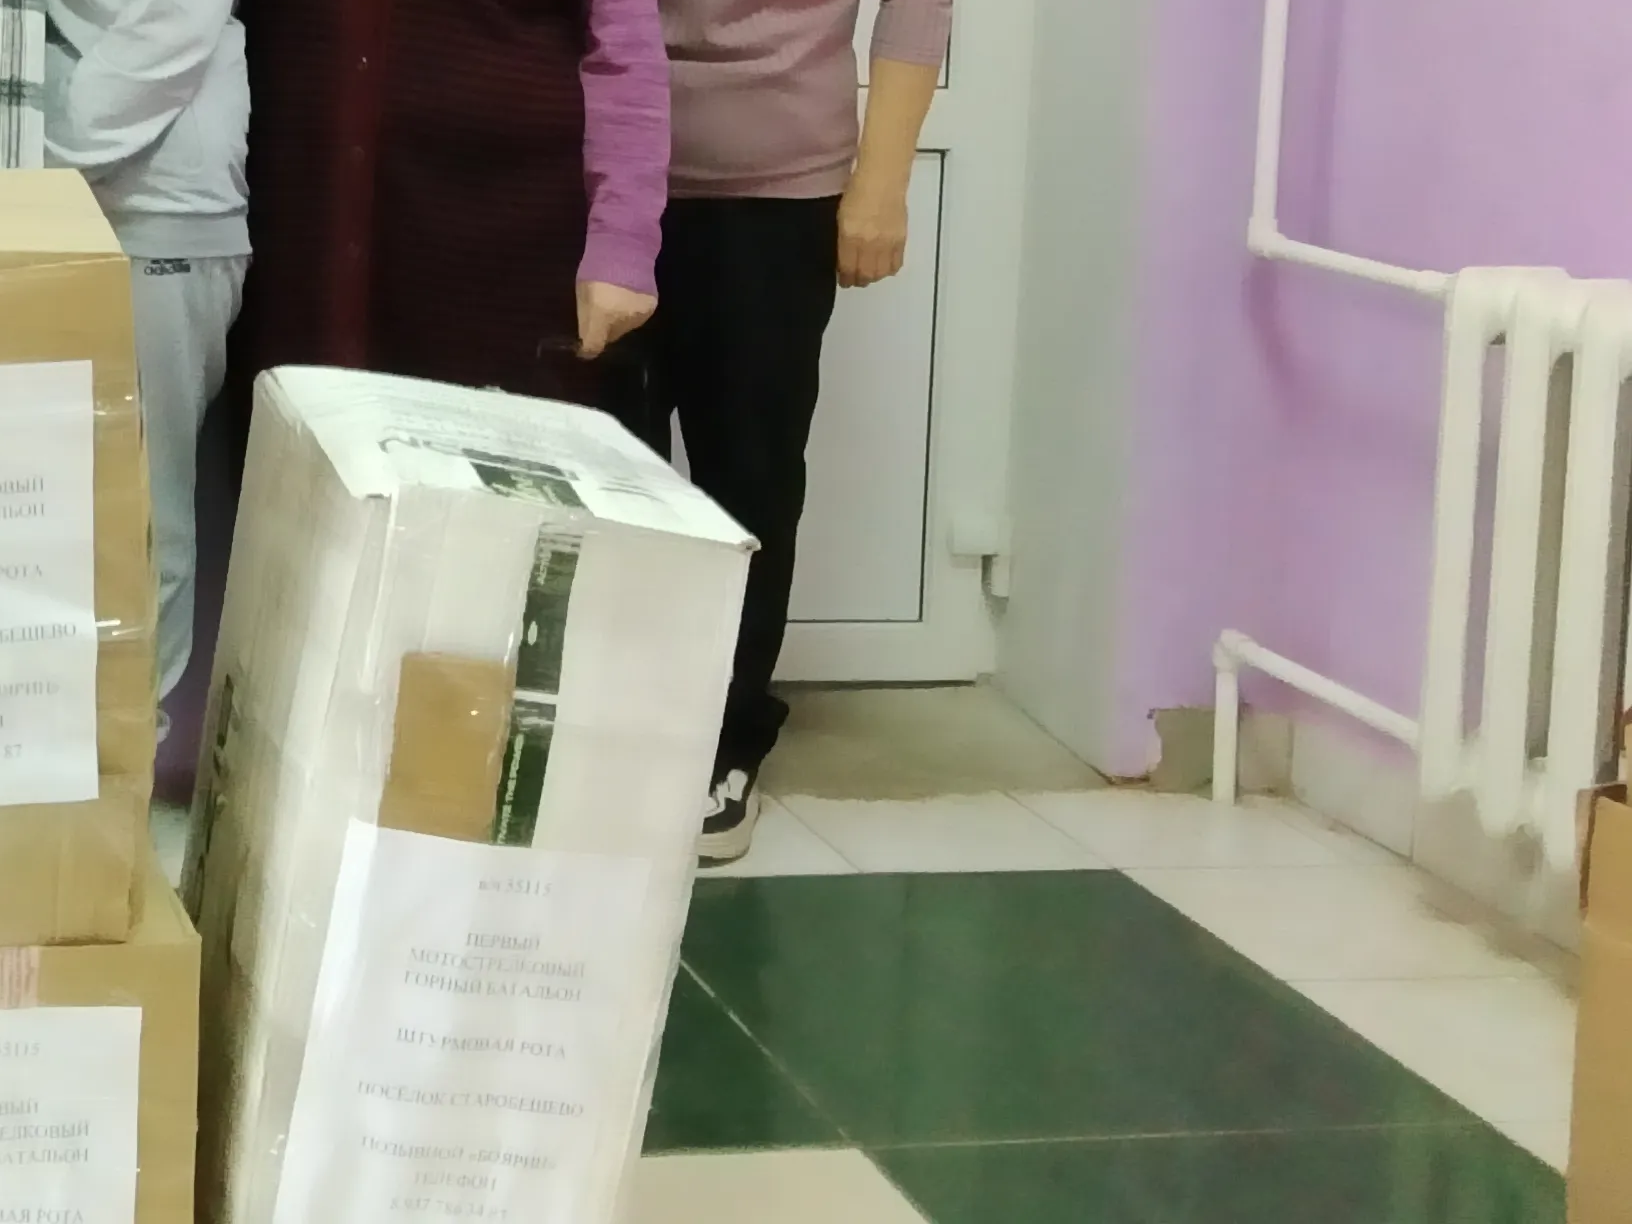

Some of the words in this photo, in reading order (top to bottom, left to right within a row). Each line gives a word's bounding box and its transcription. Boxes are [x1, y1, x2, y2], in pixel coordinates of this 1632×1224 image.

[466, 932, 540, 951] ПЕРВЫЙ
[410, 947, 586, 978] МОТОСТРЕЛКОВЫЙ
[404, 970, 482, 995] ГОРНЫЙ
[486, 981, 582, 1002] БАТАЛЬОН
[396, 1027, 514, 1053] ШТУРМОВАЯ
[520, 1040, 566, 1059] РОТА
[450, 1091, 584, 1117] СТАРОБЕШЕВО
[362, 1136, 464, 1161] ПОЗЫВНОЙ
[36, 1205, 84, 1224] РОТА
